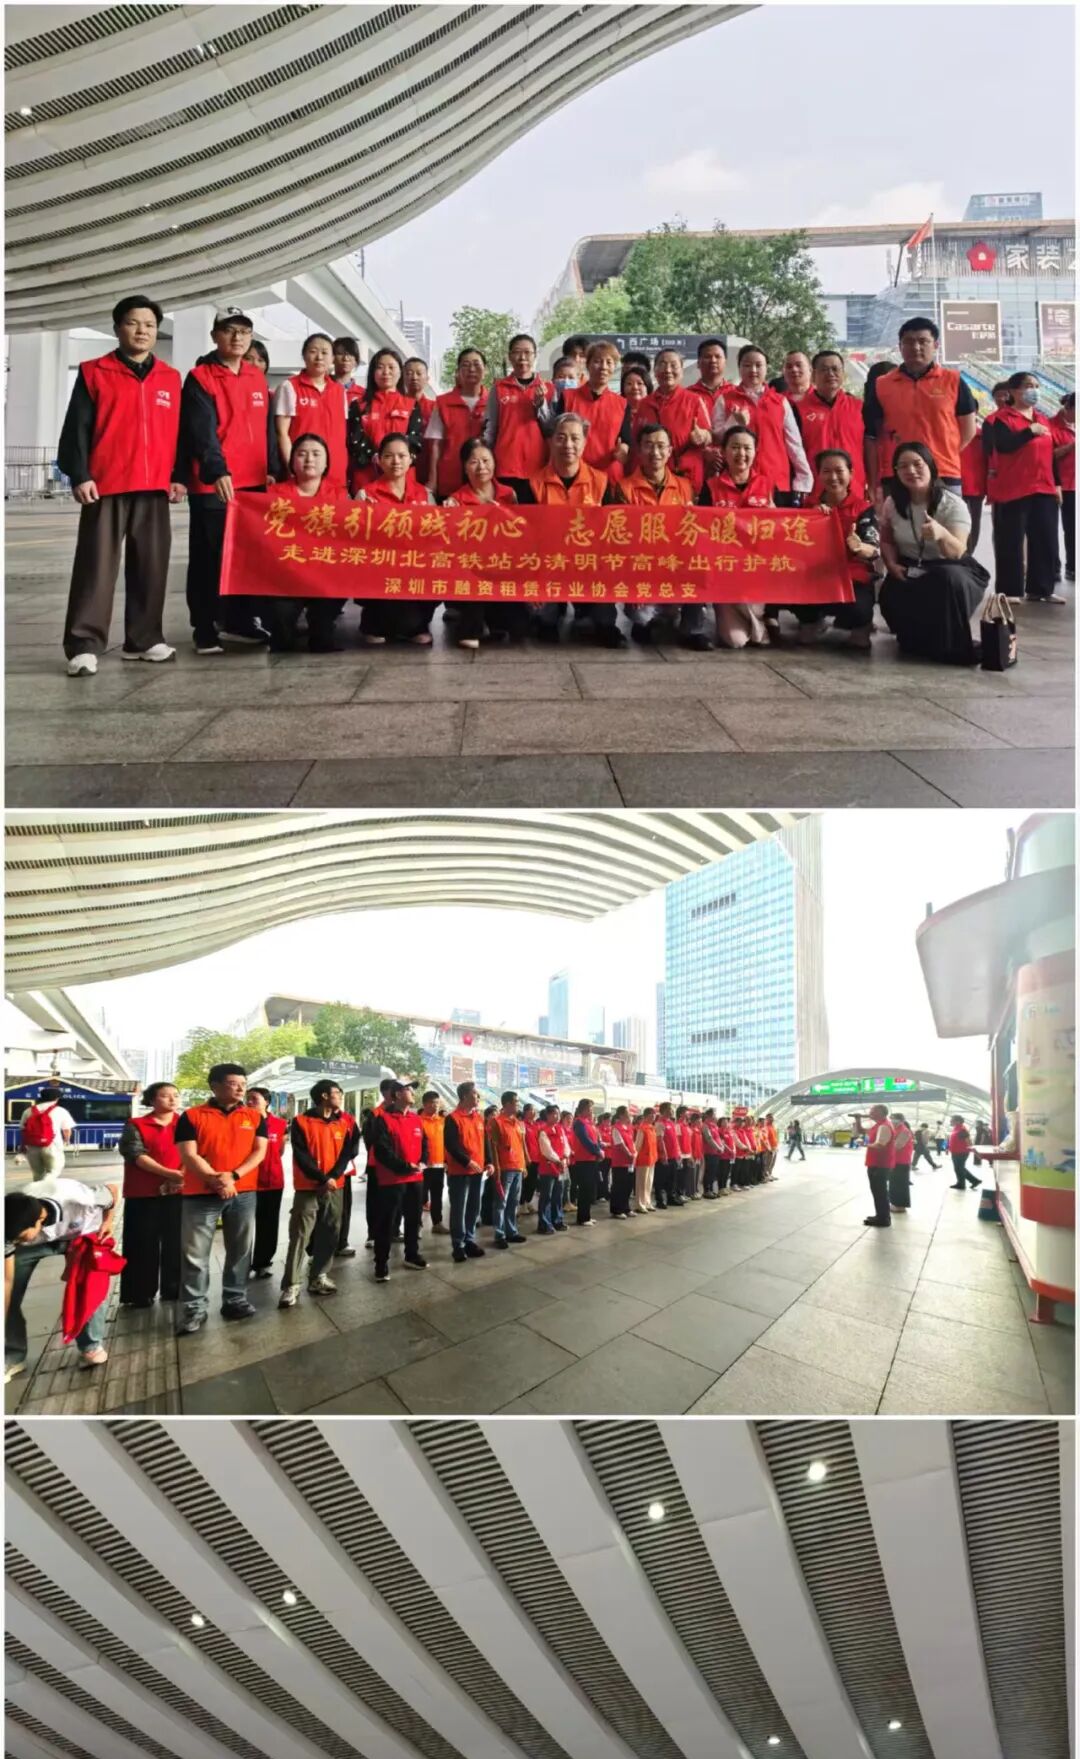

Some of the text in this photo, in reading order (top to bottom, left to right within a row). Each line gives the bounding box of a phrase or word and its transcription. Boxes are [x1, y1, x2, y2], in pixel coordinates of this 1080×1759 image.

[629, 337, 659, 346] 西广场
[263, 496, 816, 548] 党旗引领践初心 志愿服务暖归途
[278, 544, 797, 573] 走进深圳北高铁站为清明节高峰出行护航
[384, 577, 698, 599] 深圳市融资租赁行业协会党总支
